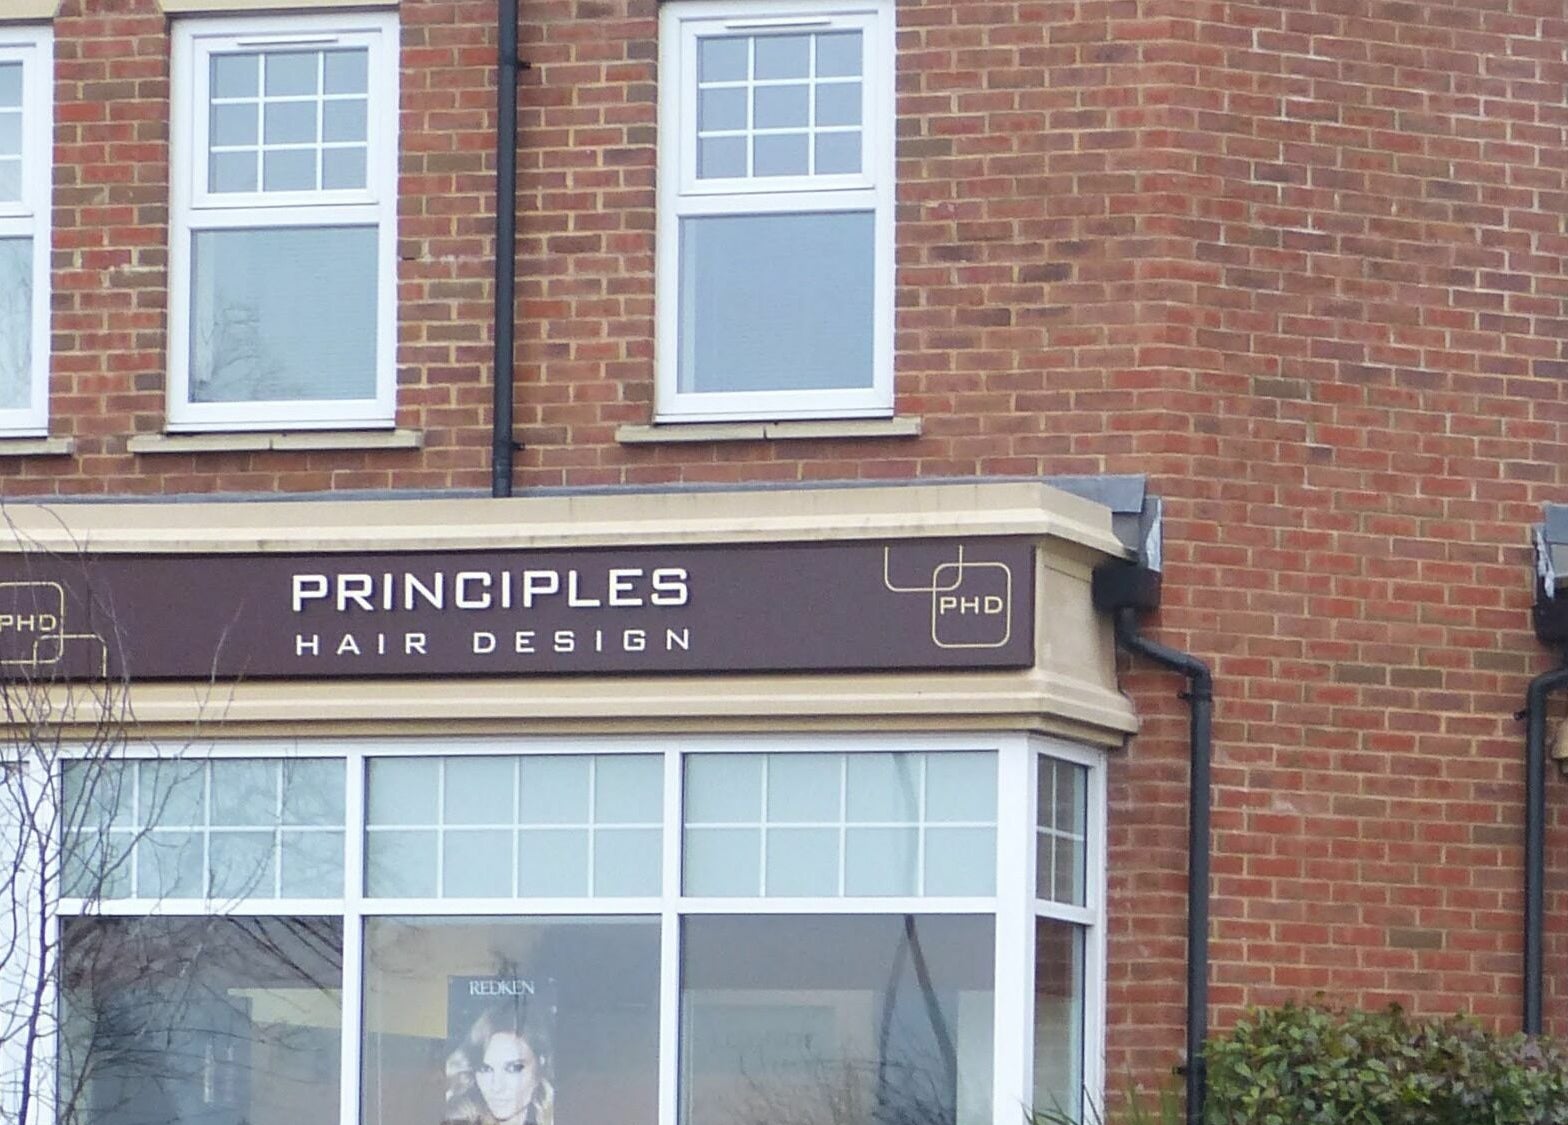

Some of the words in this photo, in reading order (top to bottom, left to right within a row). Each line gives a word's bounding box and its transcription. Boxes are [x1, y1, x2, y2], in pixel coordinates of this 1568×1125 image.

[292, 567, 690, 612] PRINCIPLES
[939, 595, 1004, 615] PHD
[0, 614, 57, 632] PHD
[296, 632, 429, 656] HAIR
[472, 627, 691, 655] DESIGN
[469, 979, 535, 996] REDKEN
